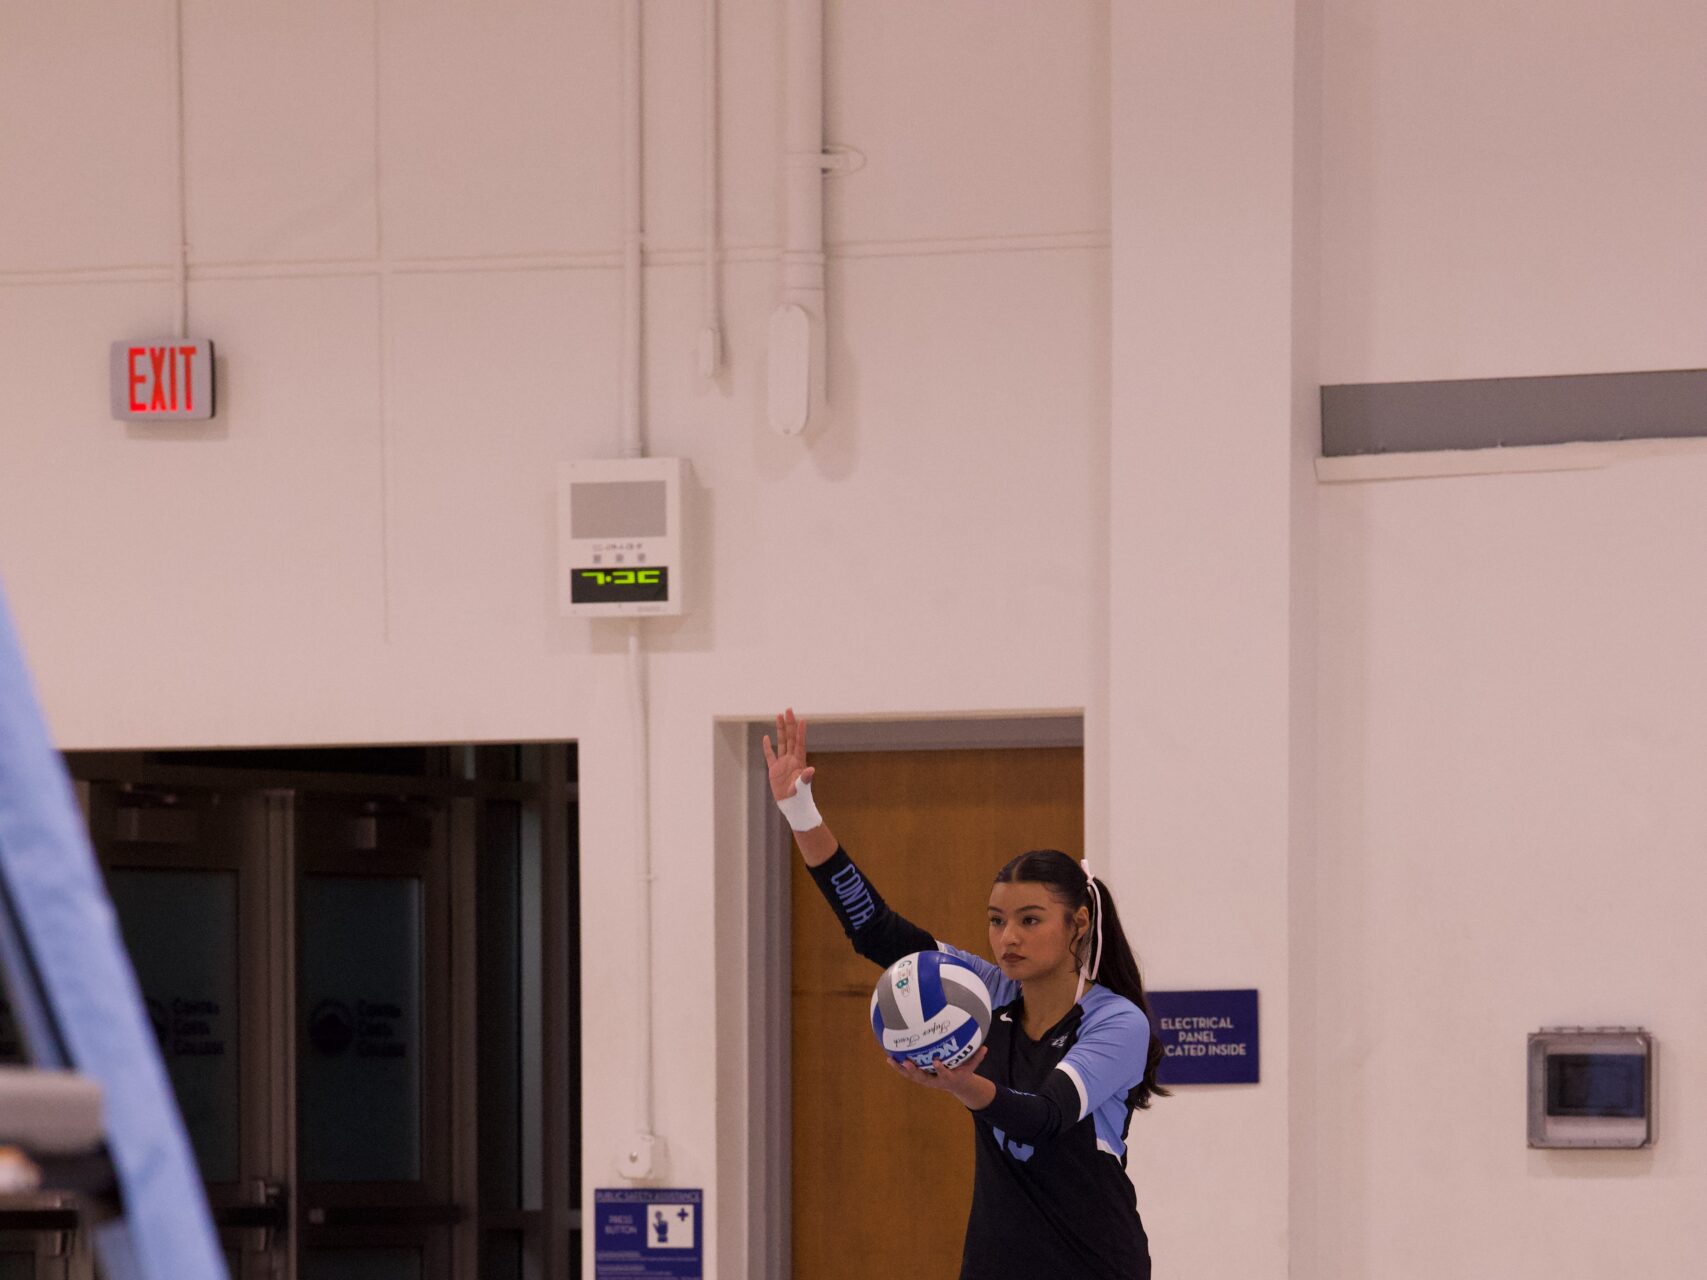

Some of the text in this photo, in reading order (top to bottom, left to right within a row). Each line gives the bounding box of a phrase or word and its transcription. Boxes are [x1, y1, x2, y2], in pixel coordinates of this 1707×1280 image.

[128, 345, 197, 413] EXIT
[831, 863, 875, 930] CONTR
[1161, 1017, 1234, 1029] ELECTRICAL
[1178, 1031, 1217, 1043] PANEL
[1164, 1044, 1247, 1057] CATED INSIDE
